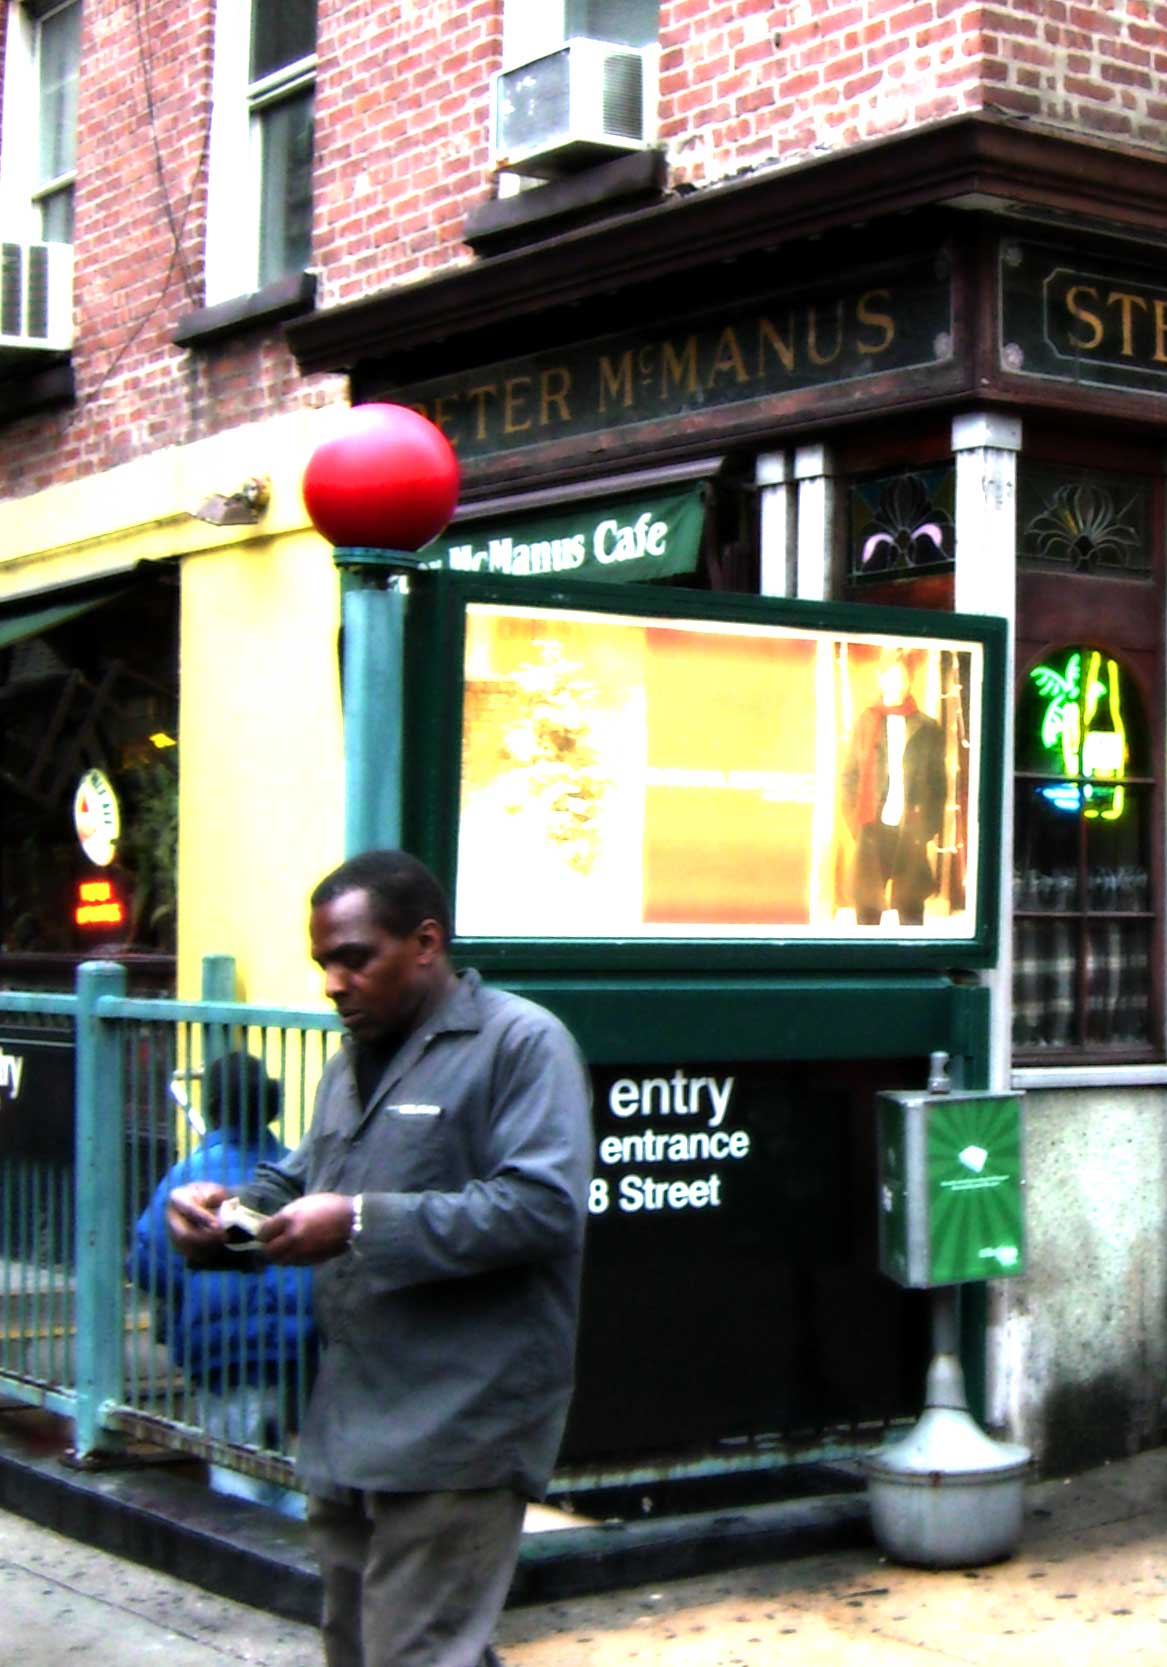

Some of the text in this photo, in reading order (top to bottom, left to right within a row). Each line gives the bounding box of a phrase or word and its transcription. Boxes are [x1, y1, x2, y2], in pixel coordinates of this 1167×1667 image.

[414, 366, 573, 446] ETER
[449, 512, 668, 576] McManus Cafe
[609, 1068, 735, 1127] entry
[600, 1129, 751, 1166] entrance
[619, 1174, 721, 1213] Street
